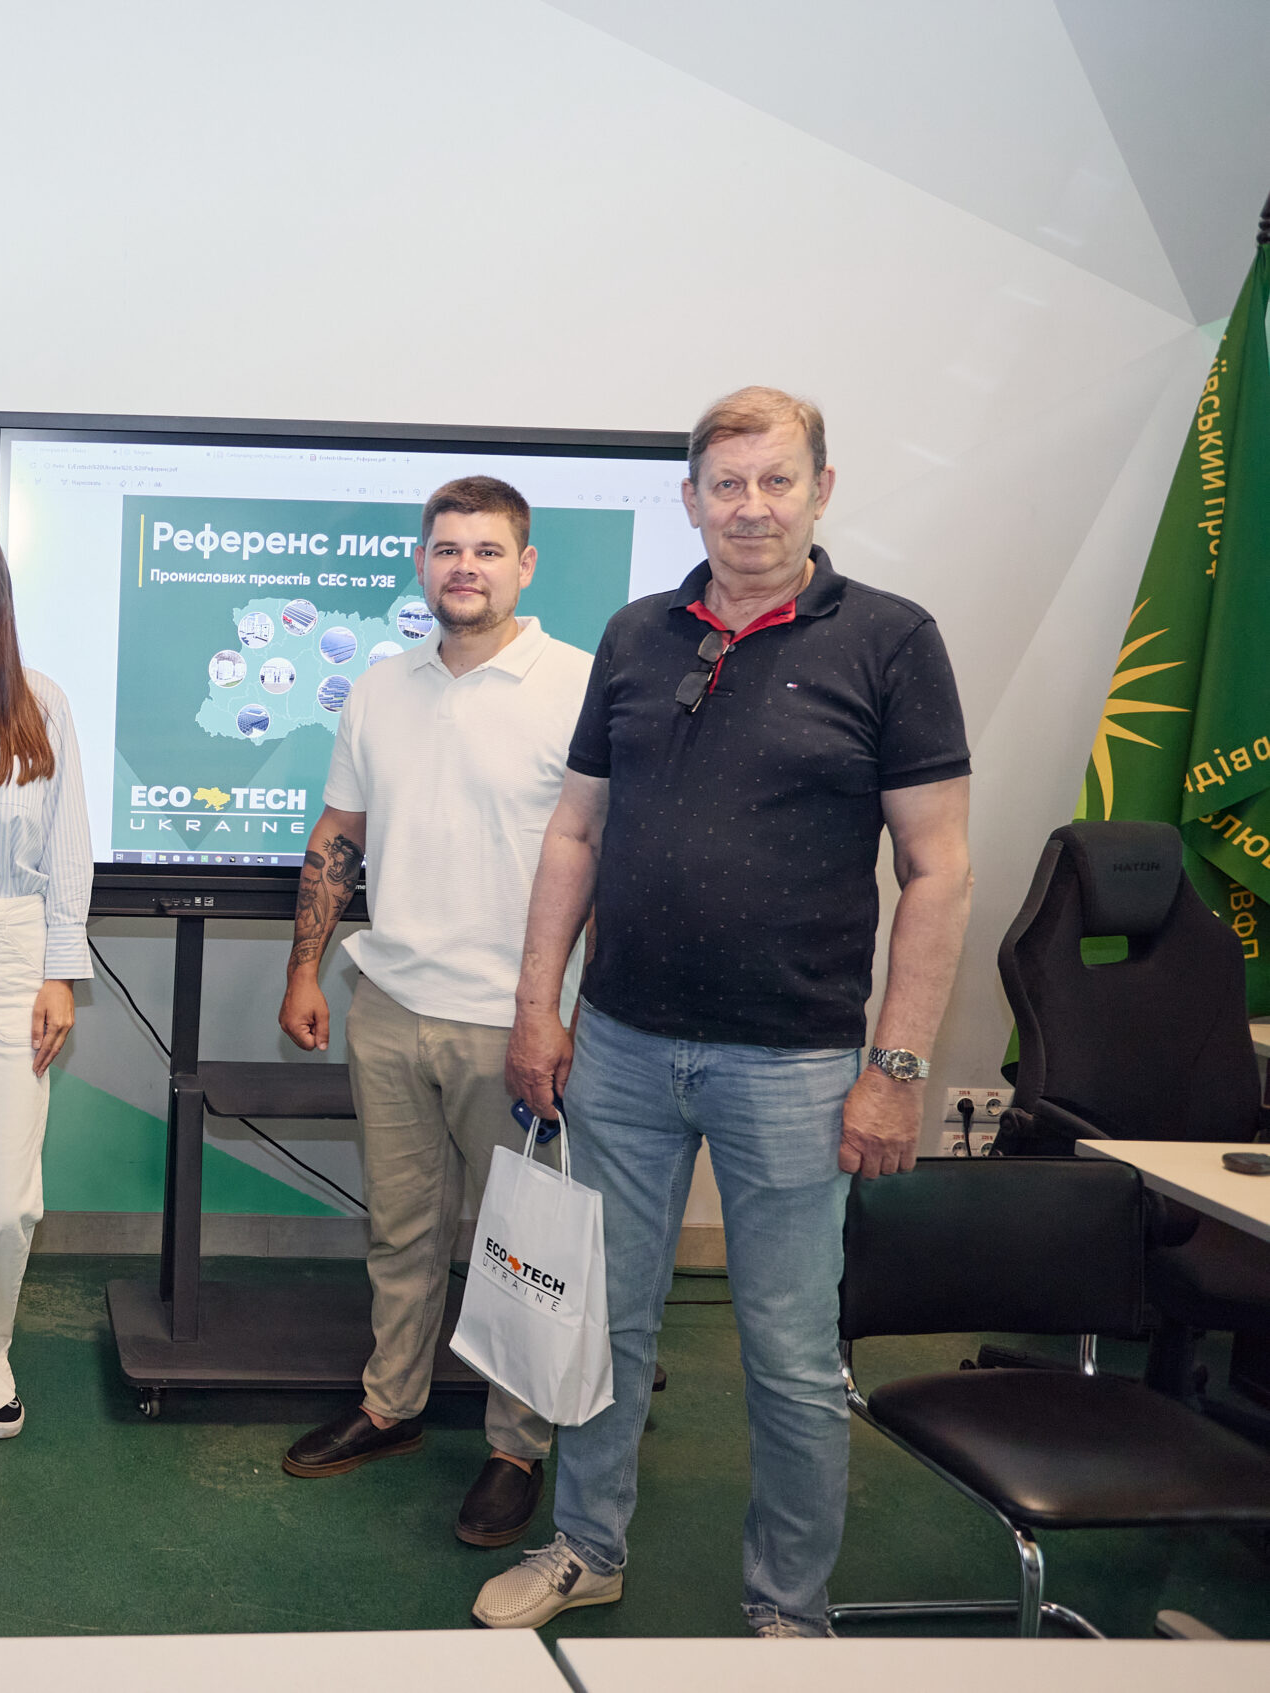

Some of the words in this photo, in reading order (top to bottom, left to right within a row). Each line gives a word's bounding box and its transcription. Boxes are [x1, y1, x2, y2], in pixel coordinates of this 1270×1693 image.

[153, 521, 329, 561] Референс
[336, 534, 418, 558] лист
[150, 568, 246, 585] Промислових
[249, 572, 311, 587] проєктів
[317, 573, 348, 587] СЕС
[350, 576, 367, 587] та
[370, 575, 396, 589] УЗЕ
[131, 785, 192, 808] ECO
[231, 787, 307, 811] TECH
[130, 818, 305, 834] UKRAINE
[486, 1237, 507, 1262] ECO
[522, 1262, 565, 1295] TECH
[482, 1256, 560, 1312] UKRAINE
